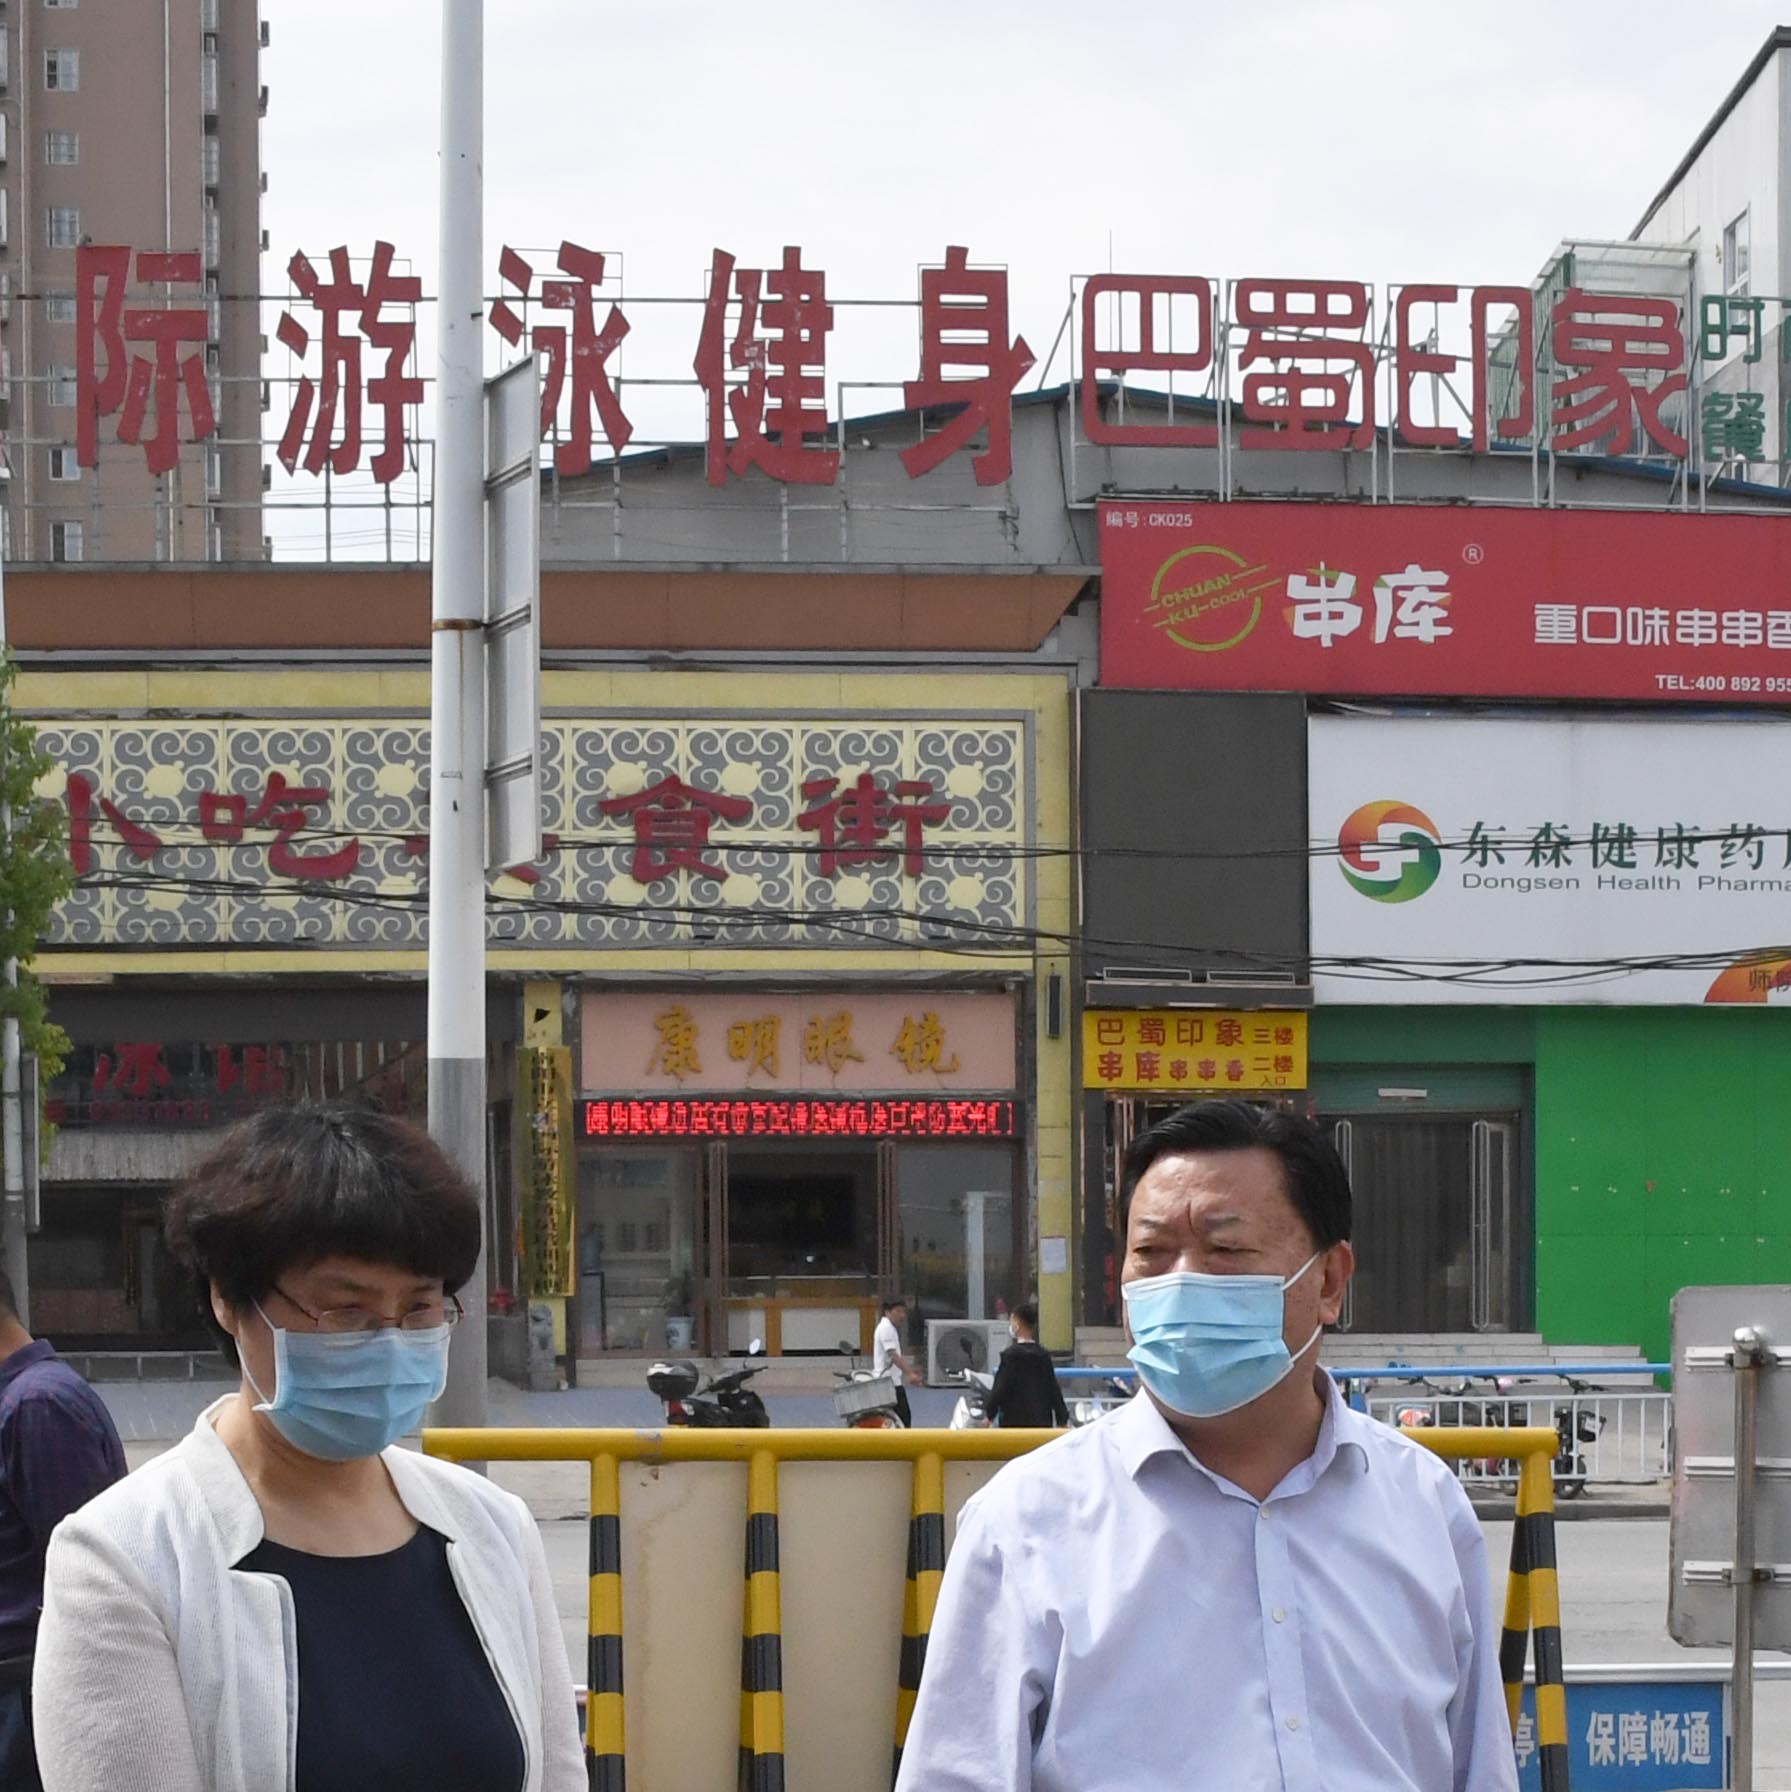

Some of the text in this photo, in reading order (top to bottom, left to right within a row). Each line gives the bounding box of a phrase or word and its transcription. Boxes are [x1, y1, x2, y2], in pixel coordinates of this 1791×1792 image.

[1081, 273, 1688, 460] 巴蜀印象
[1286, 562, 1454, 648] 串库
[1654, 673, 1726, 692] TEL:400
[1730, 674, 1761, 693] 892
[67, 770, 952, 885] 小吃食街
[1462, 872, 1580, 894] Dongsen
[1596, 873, 1681, 892] Health
[1096, 1017, 1295, 1047] 巴蜀印象 三楼
[1097, 1051, 1161, 1083] 串库
[1252, 1055, 1295, 1074] 二楼
[1585, 1710, 1712, 1767] 保障畅通
